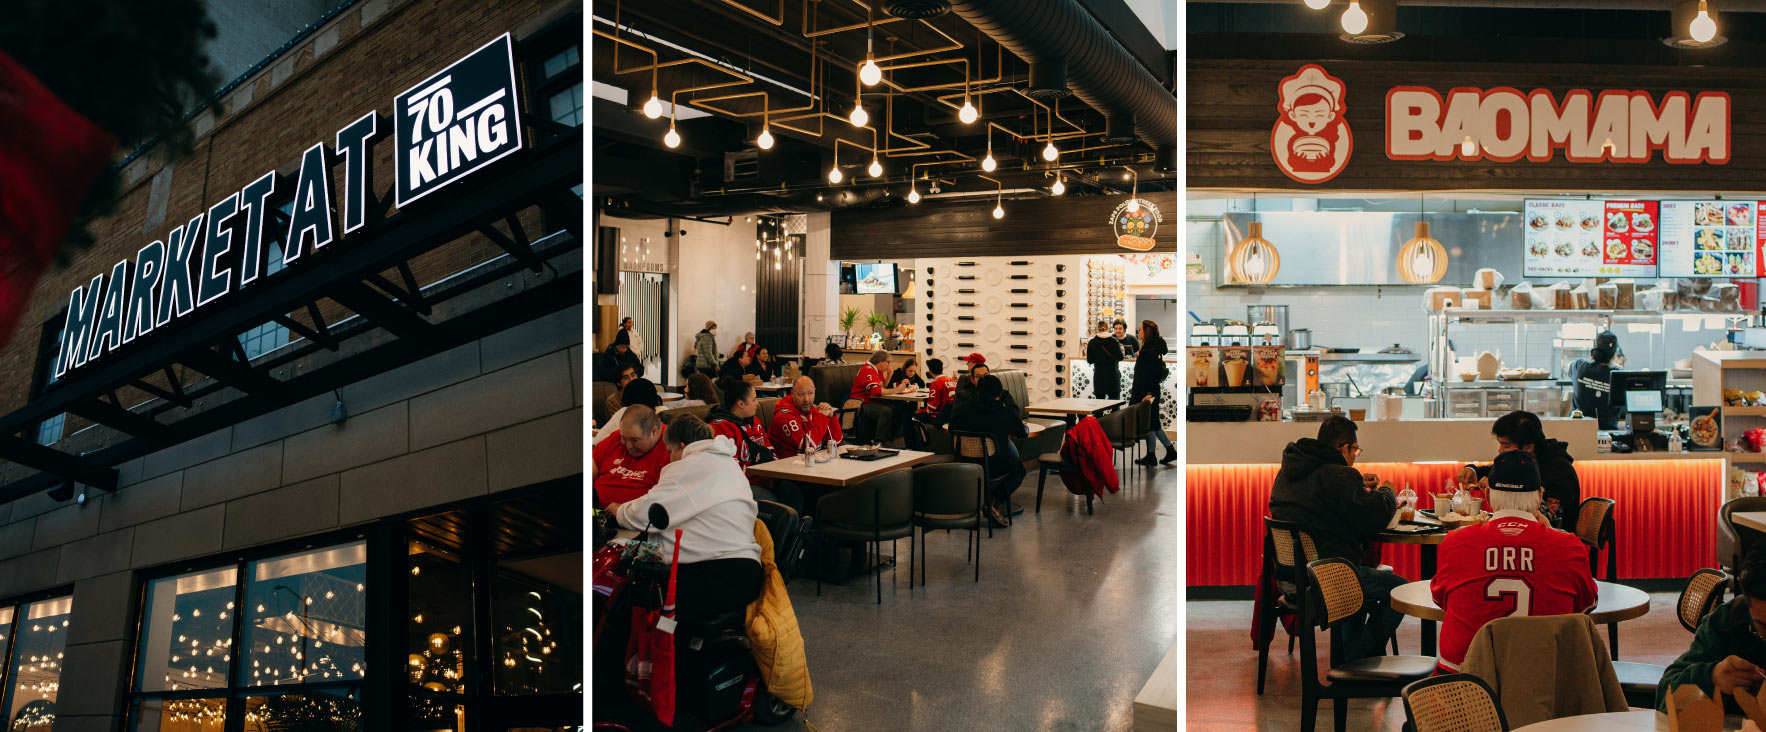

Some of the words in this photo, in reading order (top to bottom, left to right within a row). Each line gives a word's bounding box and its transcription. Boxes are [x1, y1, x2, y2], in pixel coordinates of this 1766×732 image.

[407, 87, 454, 145] 70
[1387, 87, 1730, 163] BAOMAMA
[409, 103, 508, 191] KING
[54, 169, 276, 378] MARKET
[283, 109, 377, 265] AT
[866, 374, 873, 382] 3
[782, 419, 800, 437] 88
[1485, 546, 1535, 573] ORR
